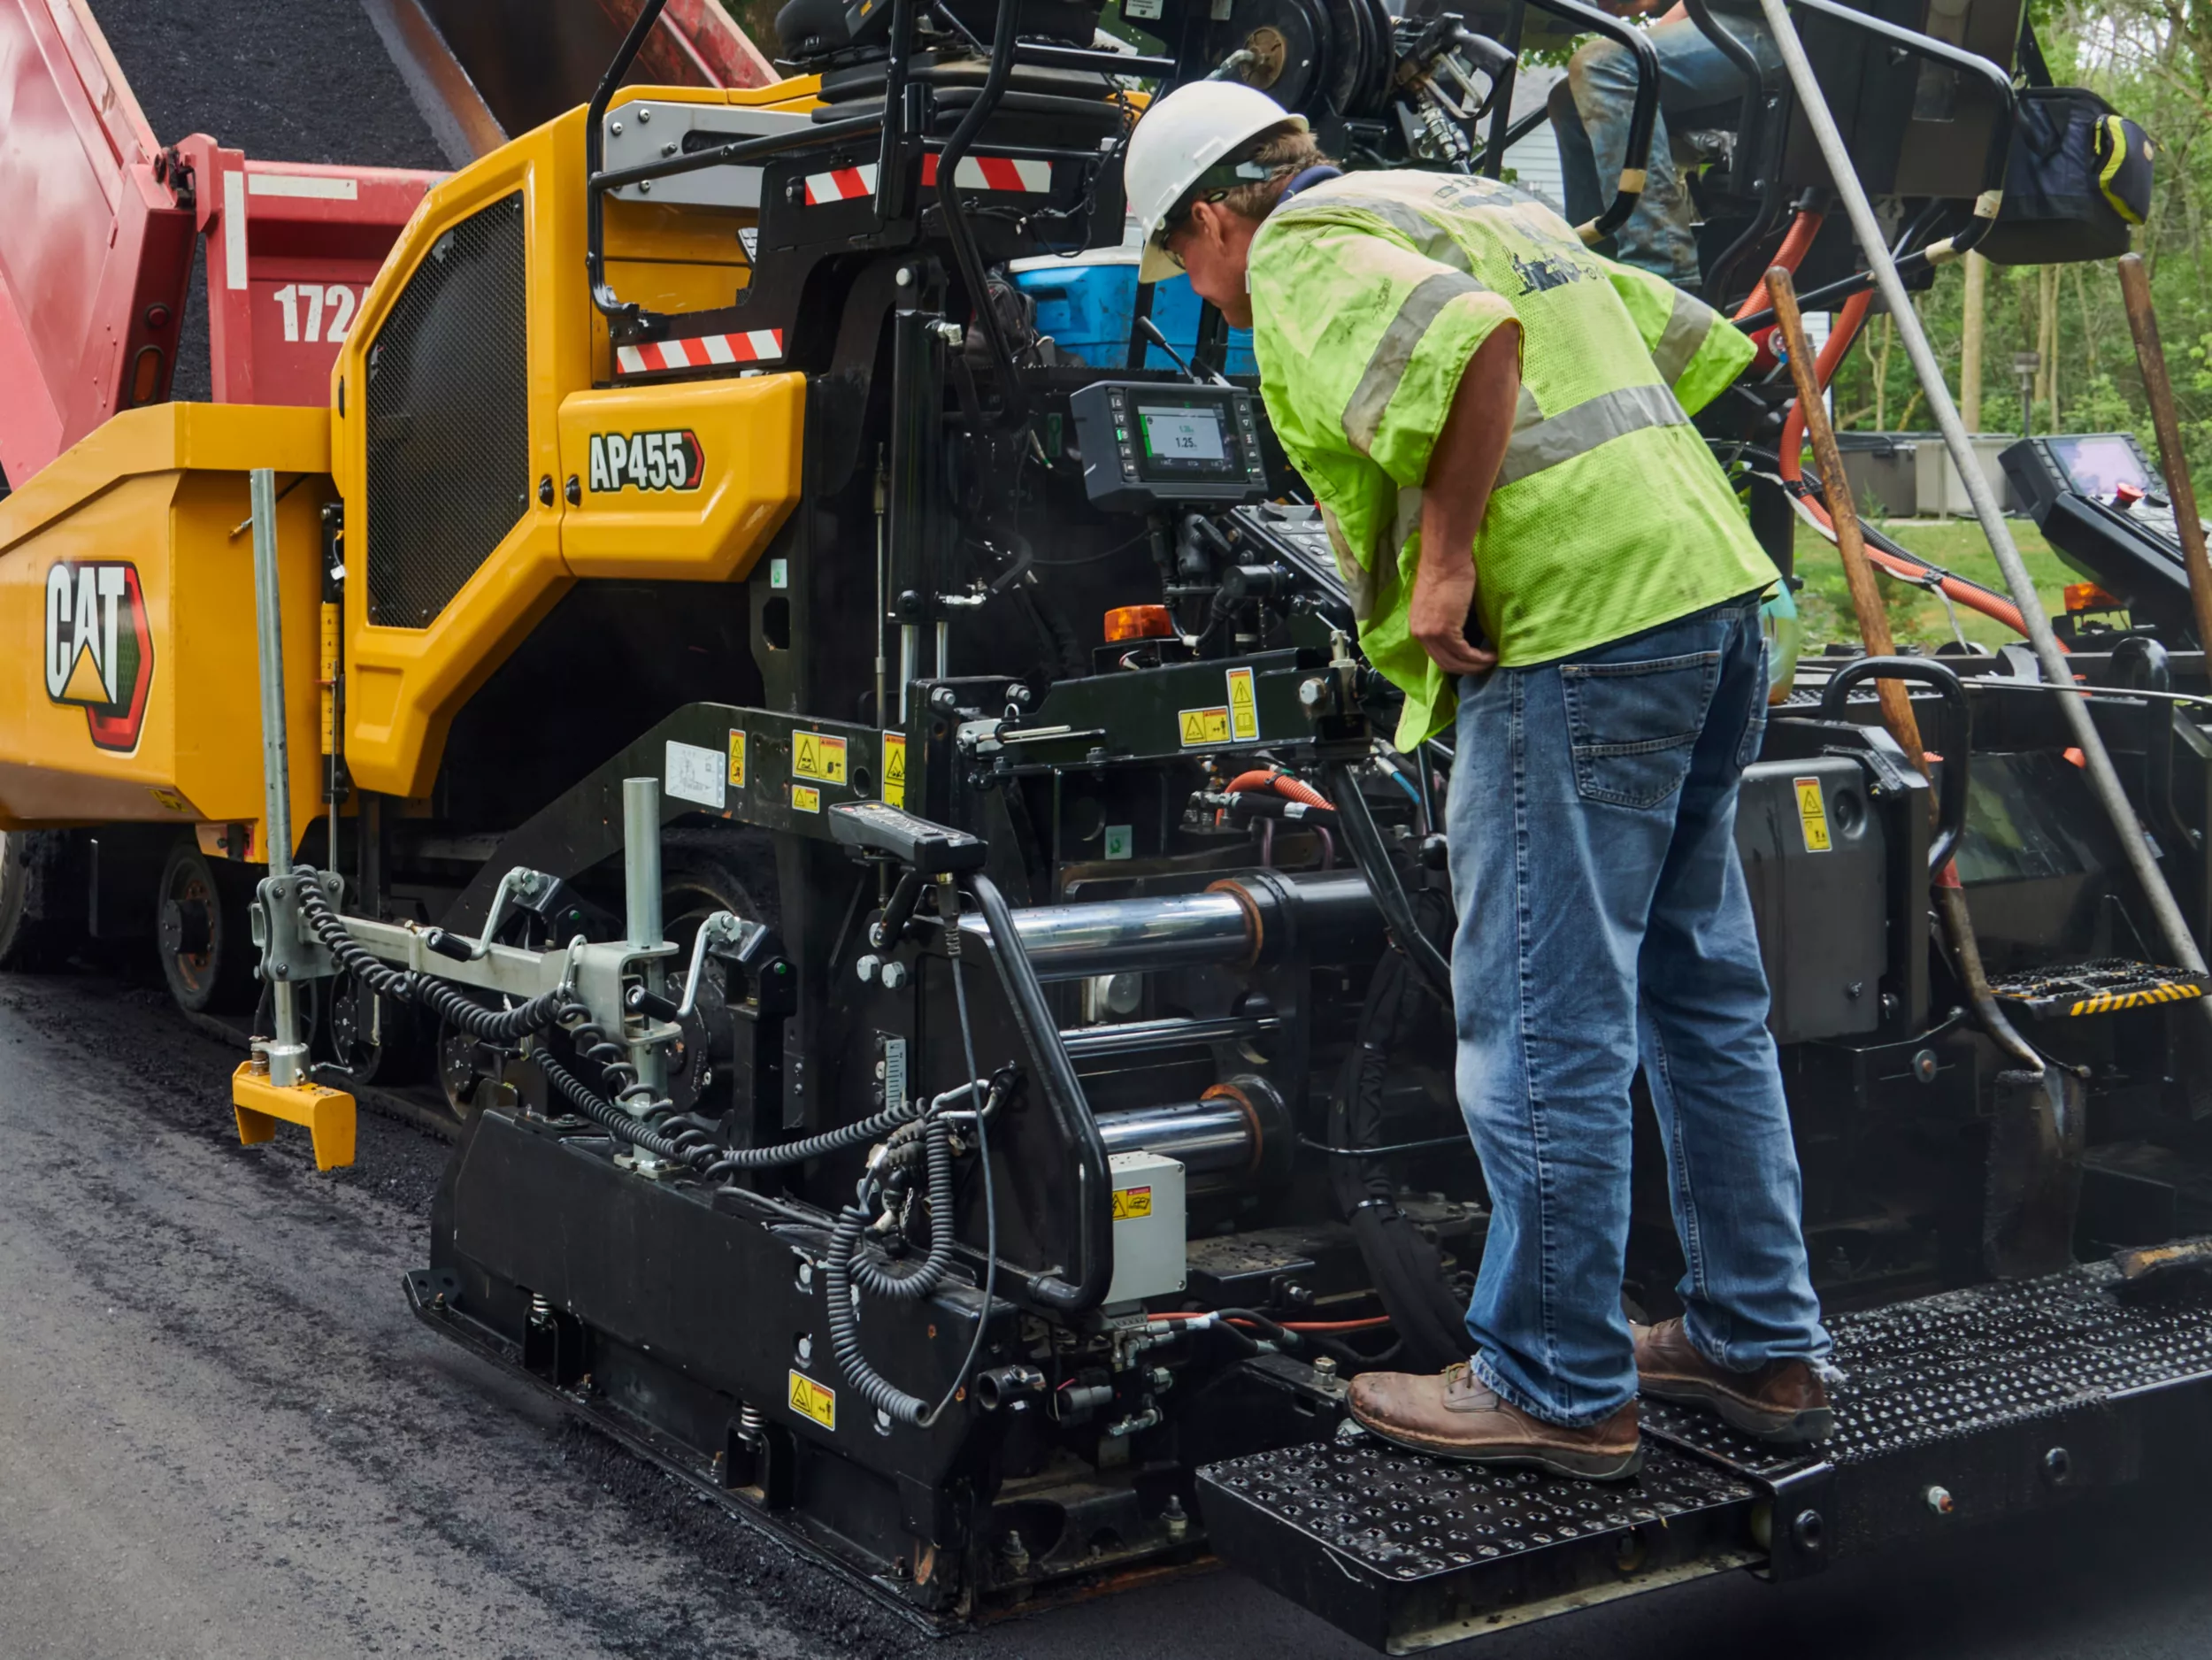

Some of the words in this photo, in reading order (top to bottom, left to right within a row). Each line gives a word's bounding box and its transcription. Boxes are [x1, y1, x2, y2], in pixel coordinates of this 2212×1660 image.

[273, 284, 373, 342] 172
[590, 432, 687, 489] AP455
[46, 564, 125, 704] CAT
